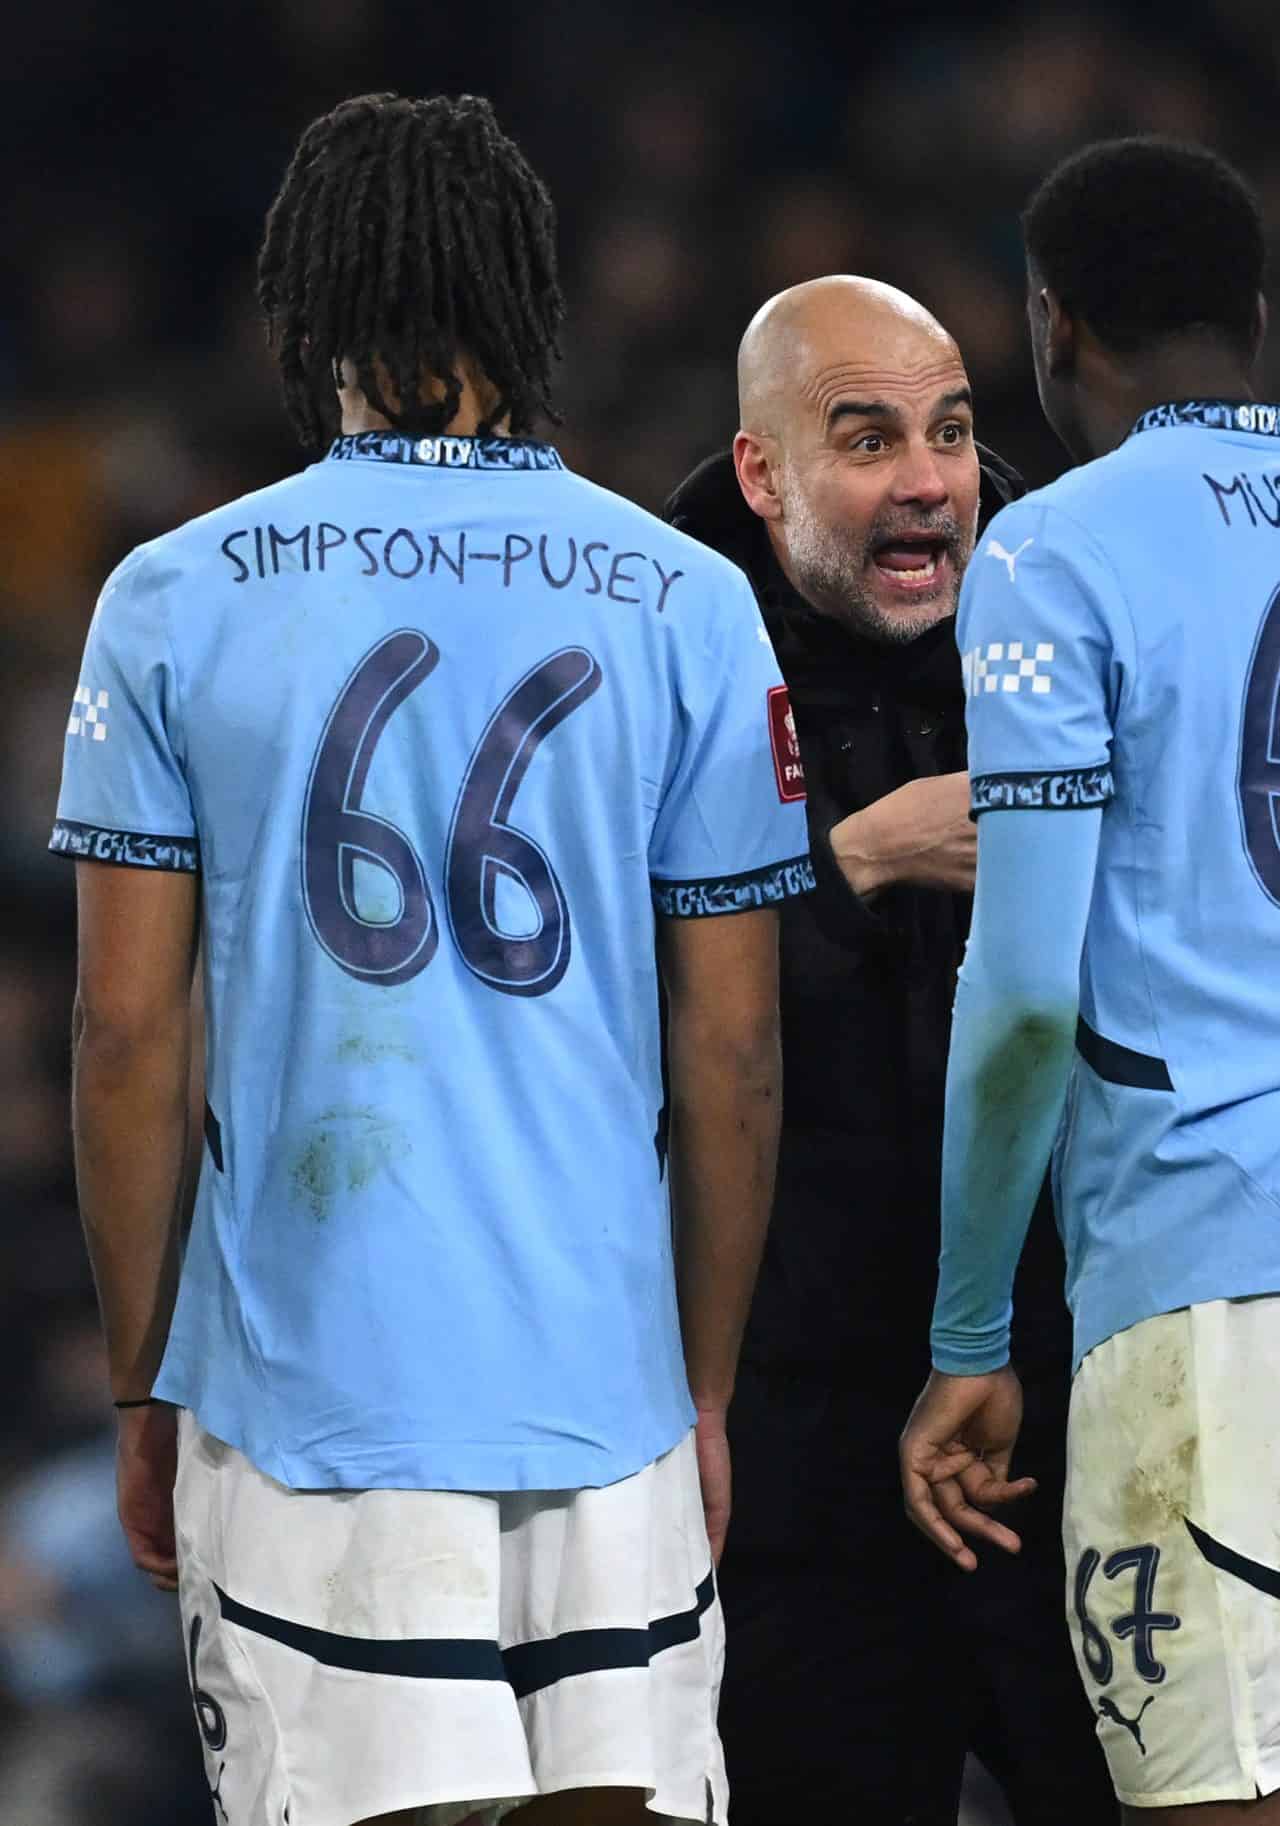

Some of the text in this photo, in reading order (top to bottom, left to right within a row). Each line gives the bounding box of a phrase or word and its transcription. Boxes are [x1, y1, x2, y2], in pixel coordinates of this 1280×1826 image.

[418, 438, 473, 464] CITY
[1238, 405, 1277, 433] CITY
[220, 522, 684, 613] SIMPSON-PUSEY
[300, 626, 604, 999] 66
[1074, 1543, 1181, 1687] 67
